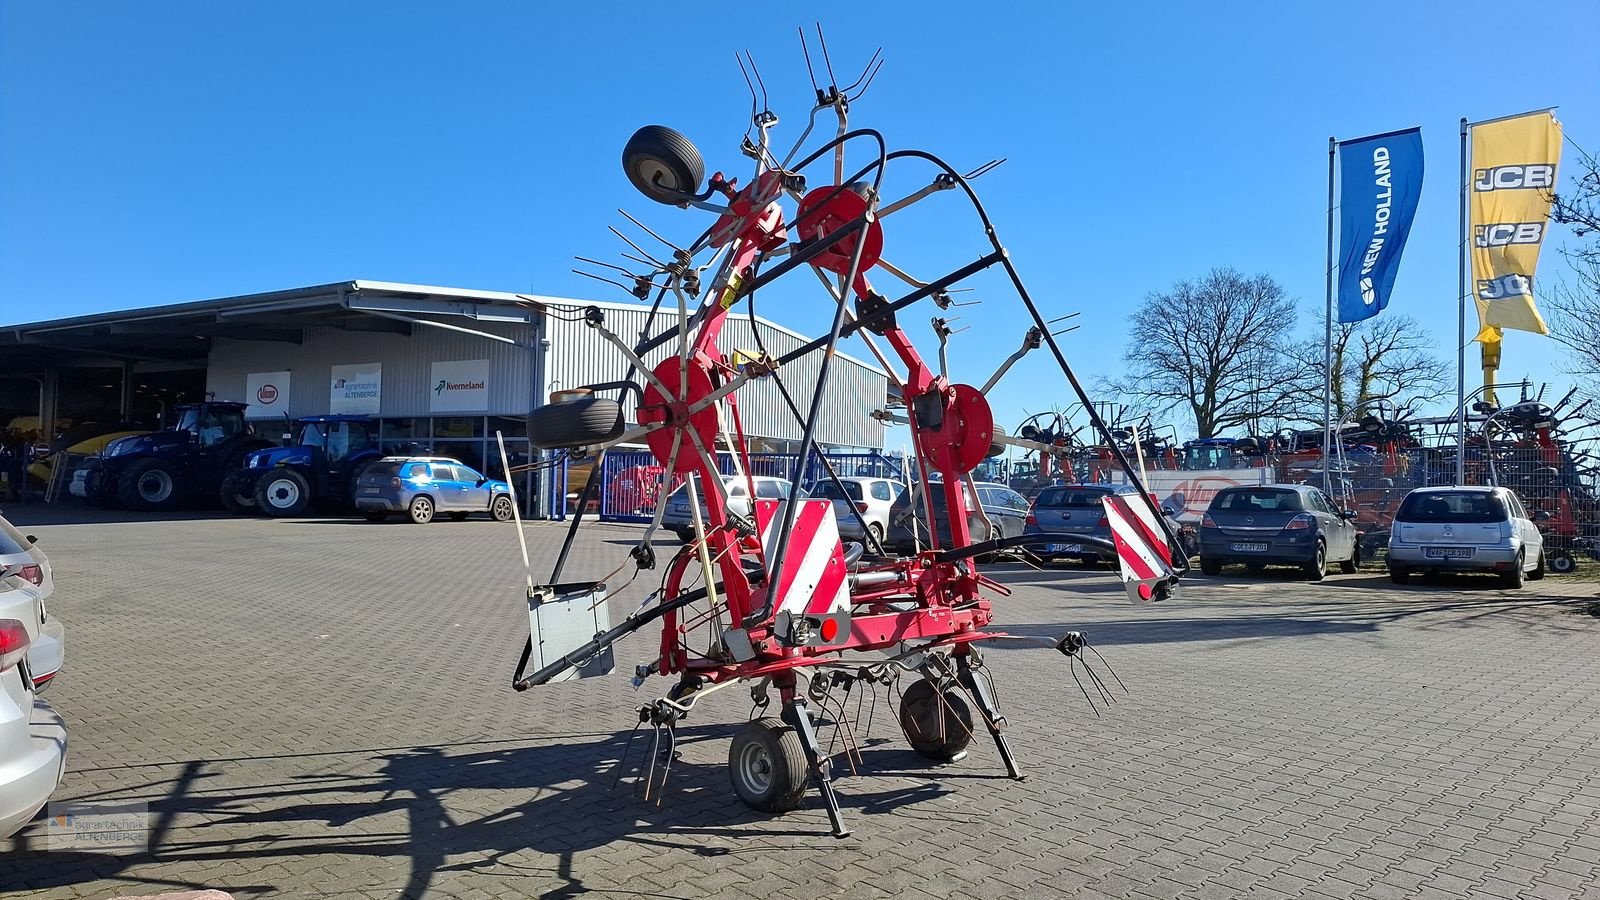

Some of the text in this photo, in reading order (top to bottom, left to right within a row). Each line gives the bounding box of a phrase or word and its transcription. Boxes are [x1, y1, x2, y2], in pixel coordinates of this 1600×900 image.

[1475, 165, 1553, 190] JCB
[1361, 147, 1392, 275] NEW HOLLAND
[1476, 223, 1542, 247] JCB
[446, 380, 485, 390] Kverneland
